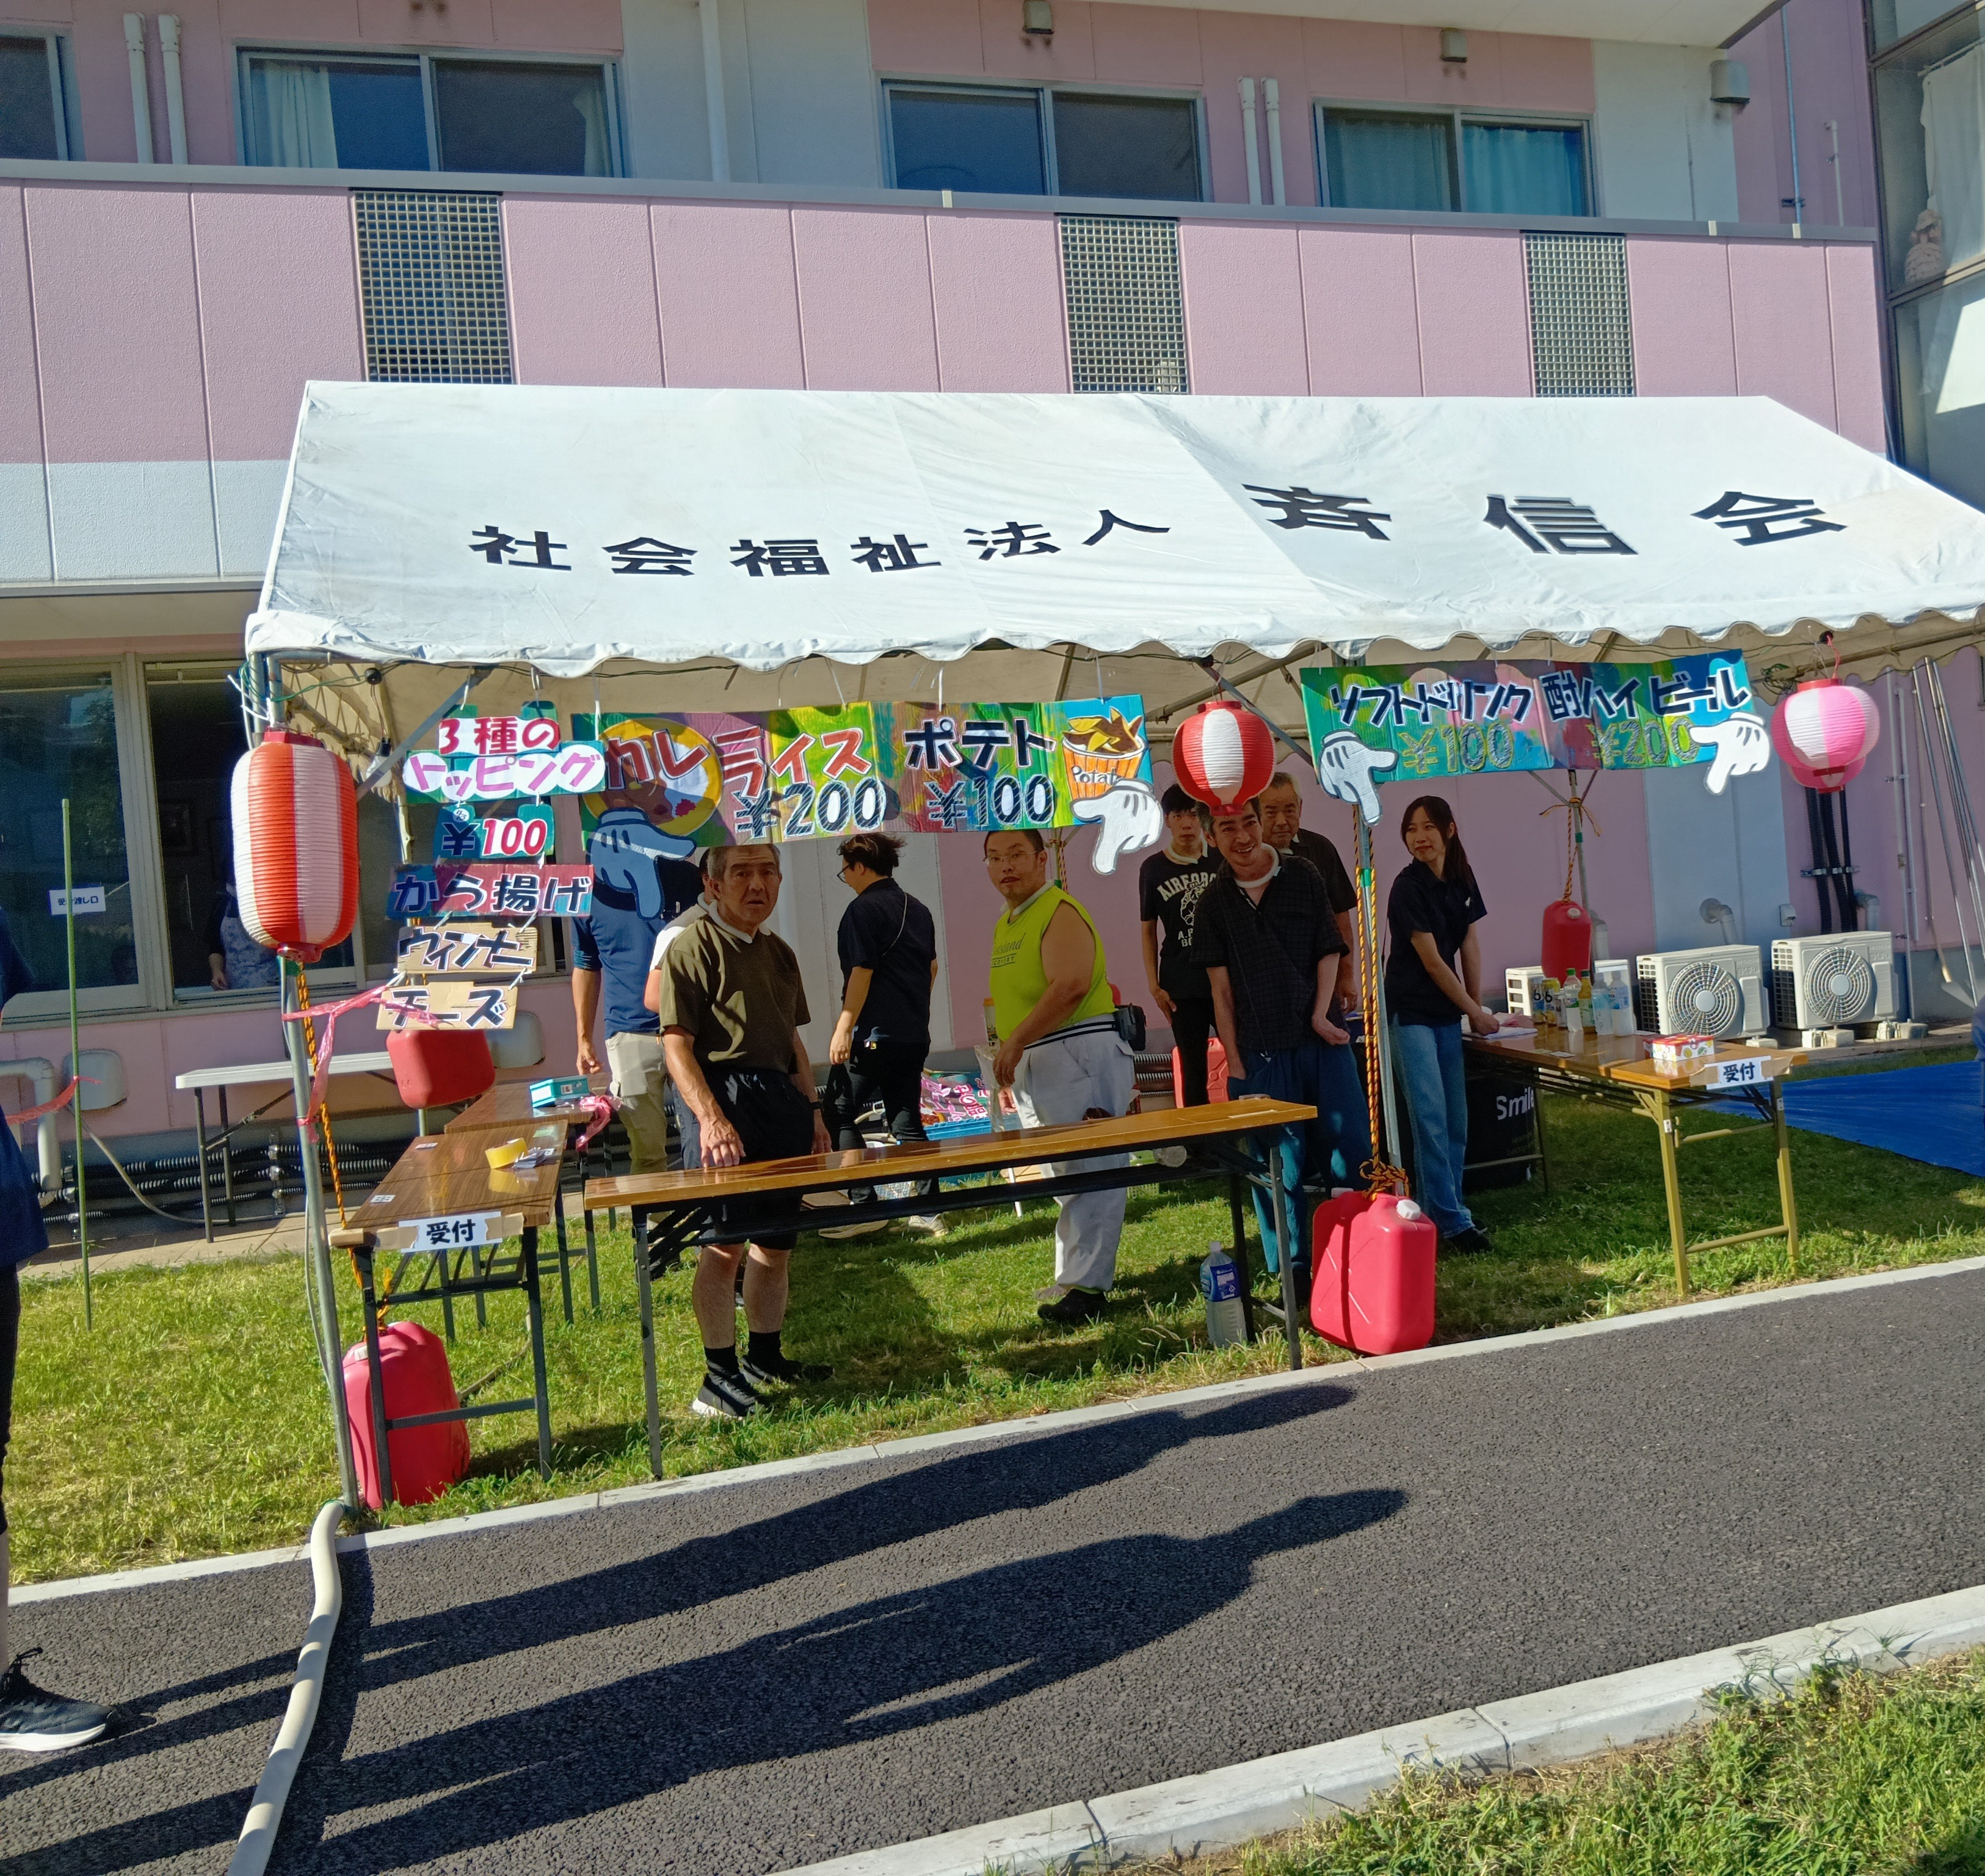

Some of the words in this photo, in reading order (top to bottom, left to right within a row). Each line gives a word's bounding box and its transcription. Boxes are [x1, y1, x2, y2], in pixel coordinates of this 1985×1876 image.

[468, 509, 1170, 577] 社会福祉法人
[1329, 679, 1534, 727] ソフトドリンク
[1538, 669, 1642, 722] 酎ハイ
[1649, 667, 1751, 716] ビール
[438, 717, 561, 755] 3種の
[904, 716, 1057, 771] ポテト
[1398, 722, 1515, 774] ¥100
[1586, 718, 1700, 766] ¥200
[405, 753, 603, 797] トッピング
[1071, 765, 1122, 787] Potat
[734, 777, 887, 838] ¥200
[924, 773, 1057, 829] ¥100
[441, 818, 547, 856] ¥100
[394, 872, 593, 914] から揚げ
[398, 927, 534, 970] ウィンナー
[385, 988, 509, 1028] チーズ
[1723, 1062, 1755, 1082] 受付
[427, 1219, 476, 1244] 受付
